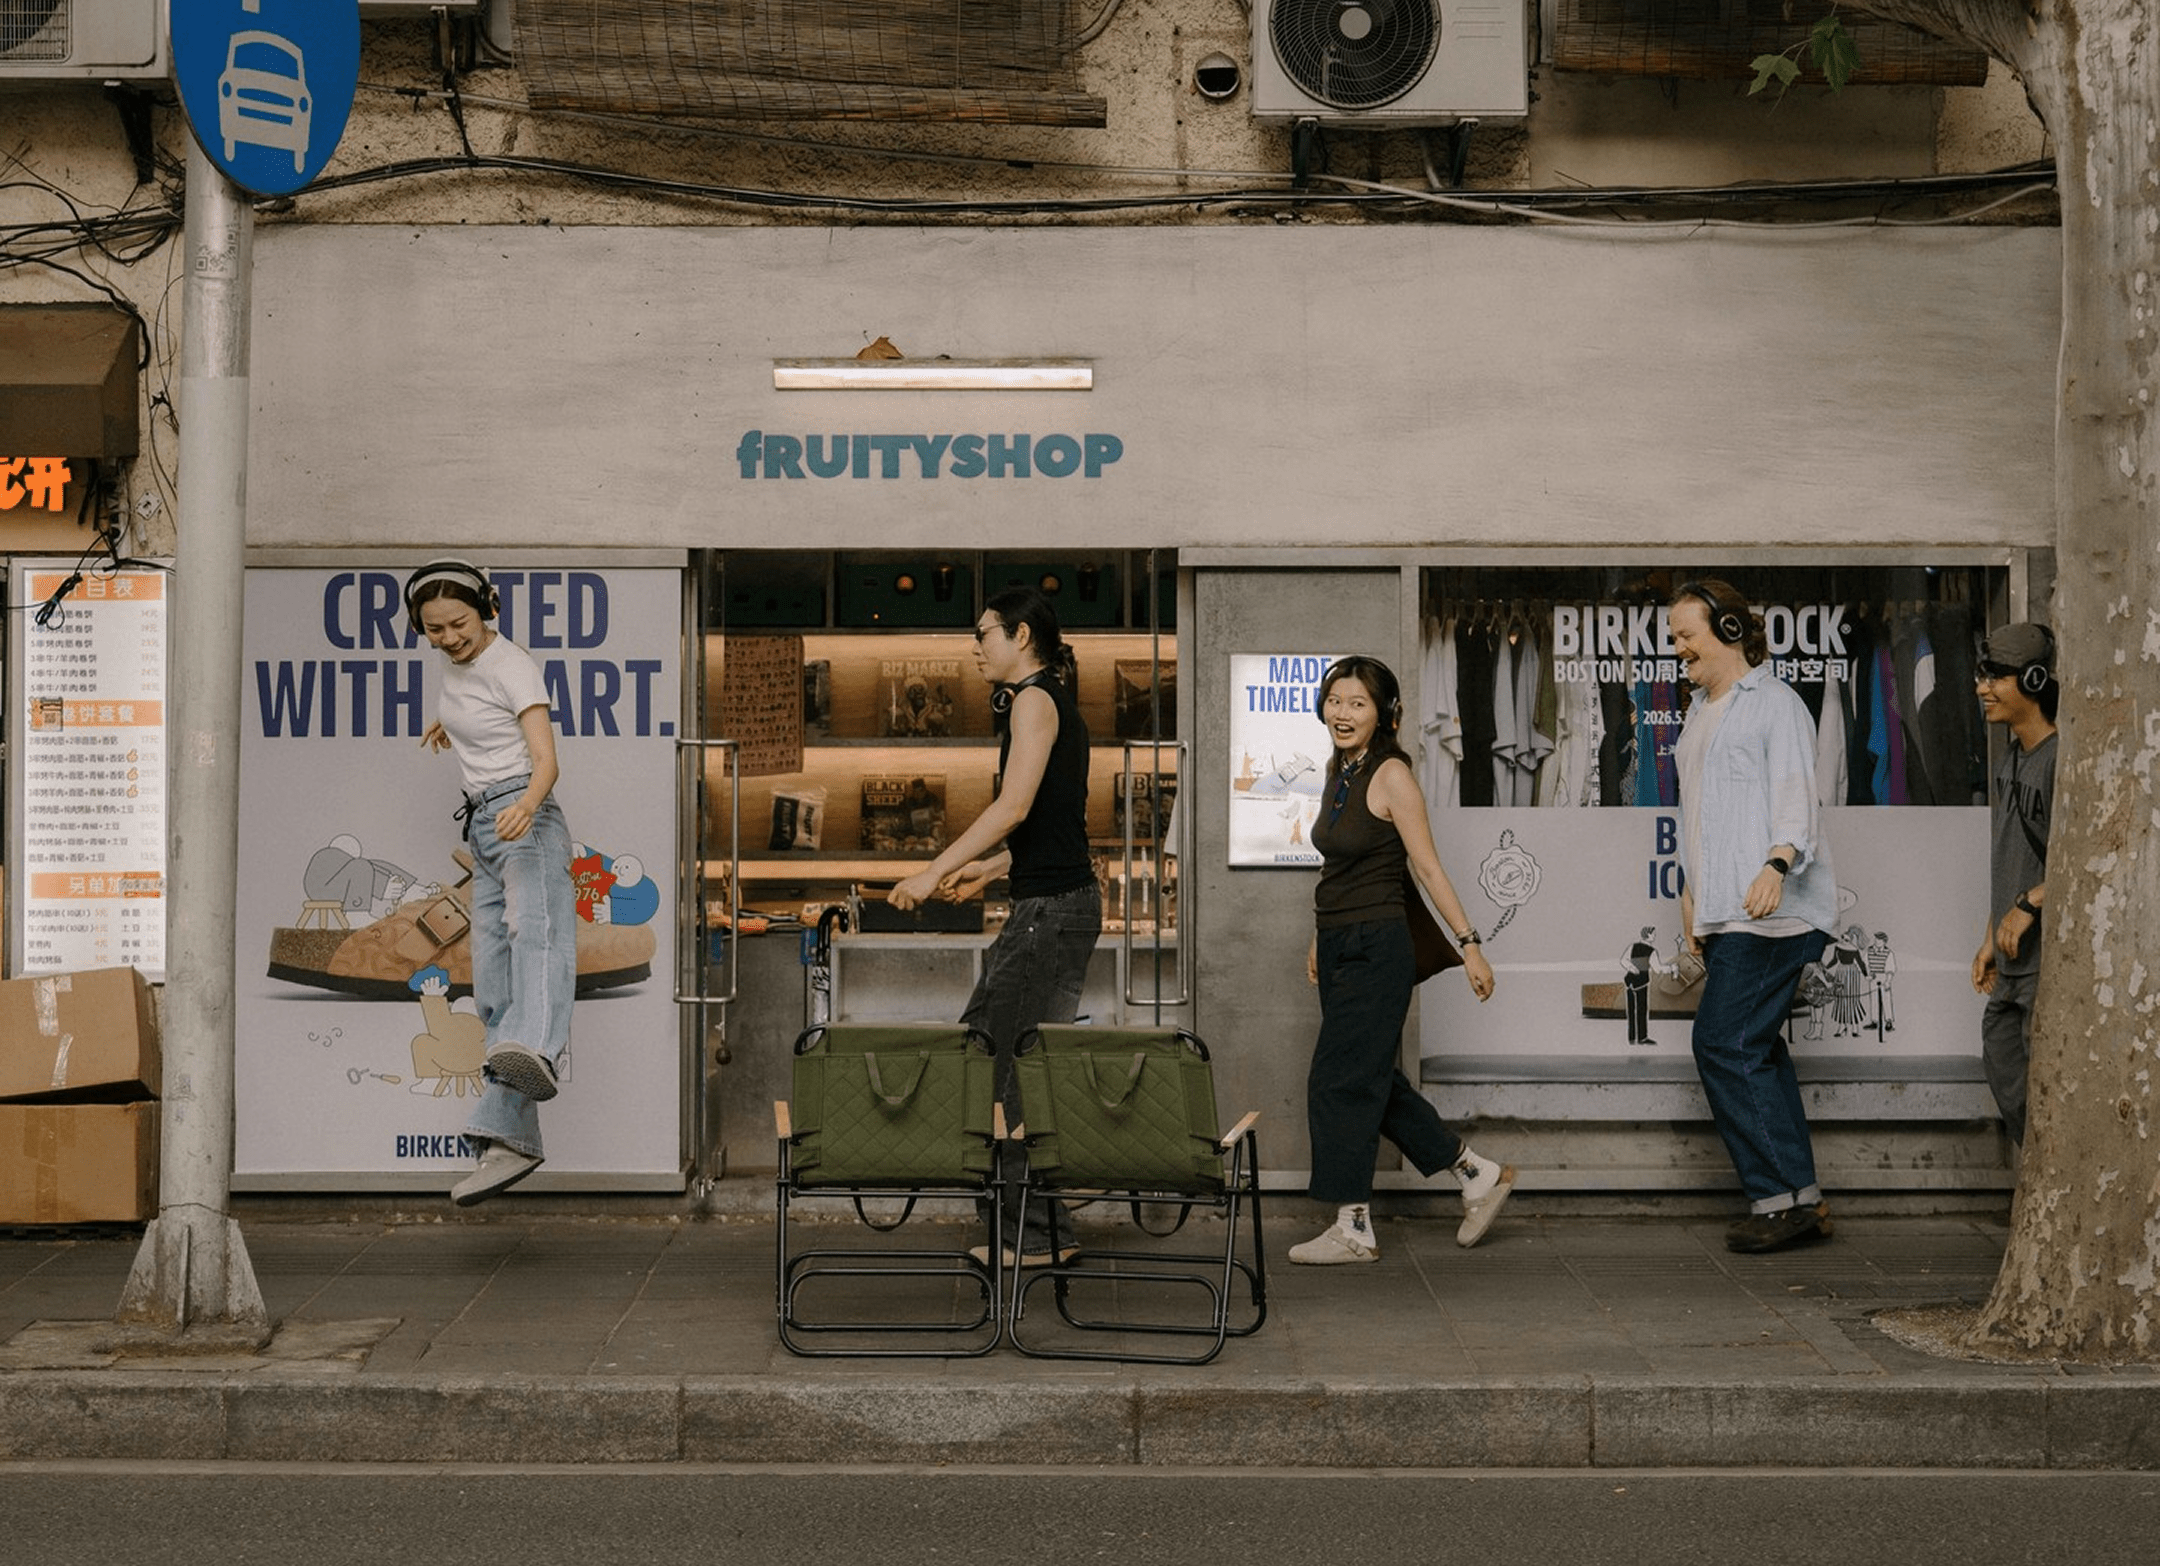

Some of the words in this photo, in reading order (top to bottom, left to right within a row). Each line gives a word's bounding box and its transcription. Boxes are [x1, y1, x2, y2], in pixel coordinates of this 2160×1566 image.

[66, 577, 134, 598] 目表
[323, 572, 609, 650] CRTED
[1554, 660, 1626, 684] BOSTON
[255, 660, 424, 737] WITH
[866, 781, 905, 793] BLACK
[396, 1135, 475, 1158] BIRKEN
